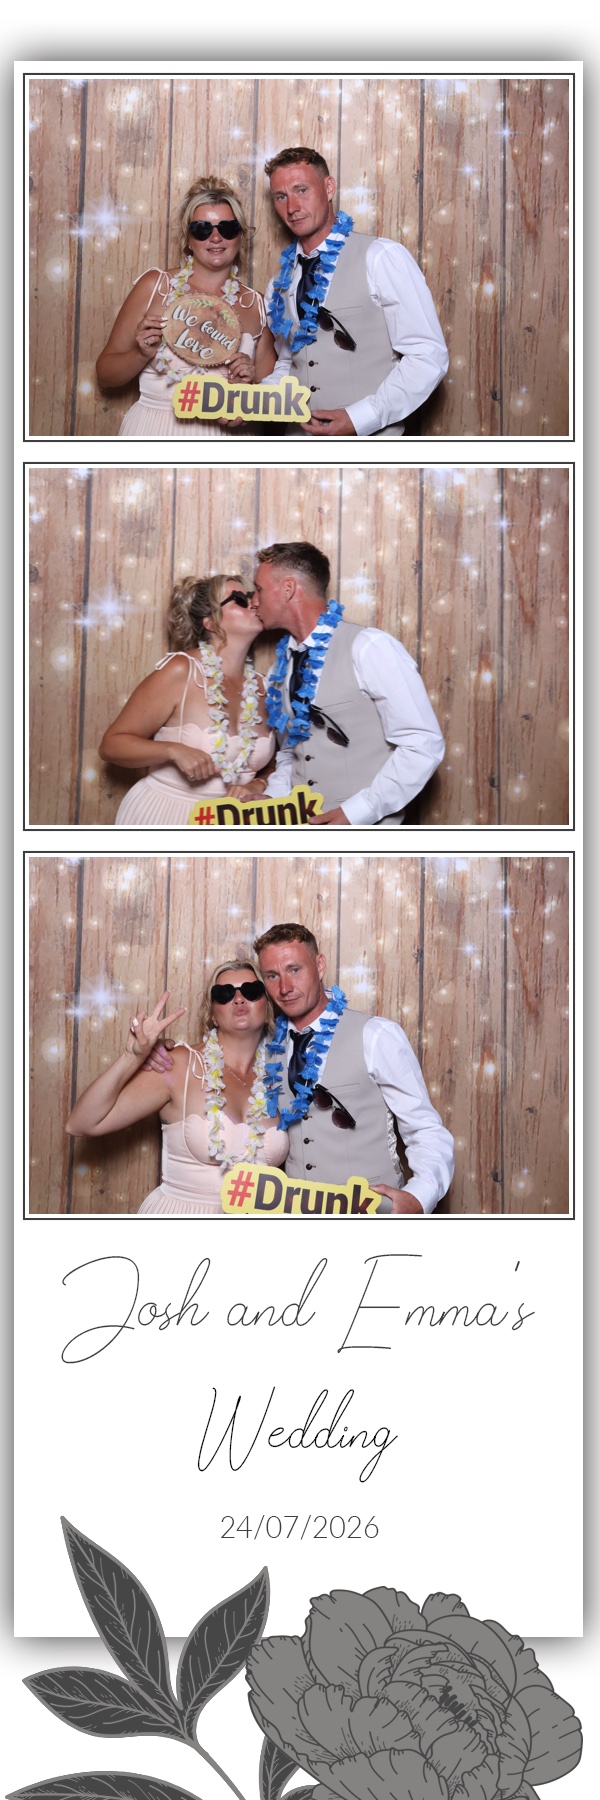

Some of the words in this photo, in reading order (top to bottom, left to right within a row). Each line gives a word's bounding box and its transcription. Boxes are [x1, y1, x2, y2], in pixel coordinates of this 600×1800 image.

[172, 305, 199, 327] We
[173, 328, 214, 360] Love
[178, 380, 305, 417] #Drunk
[194, 791, 318, 825] #Drunk
[227, 1170, 374, 1214] #Drunk
